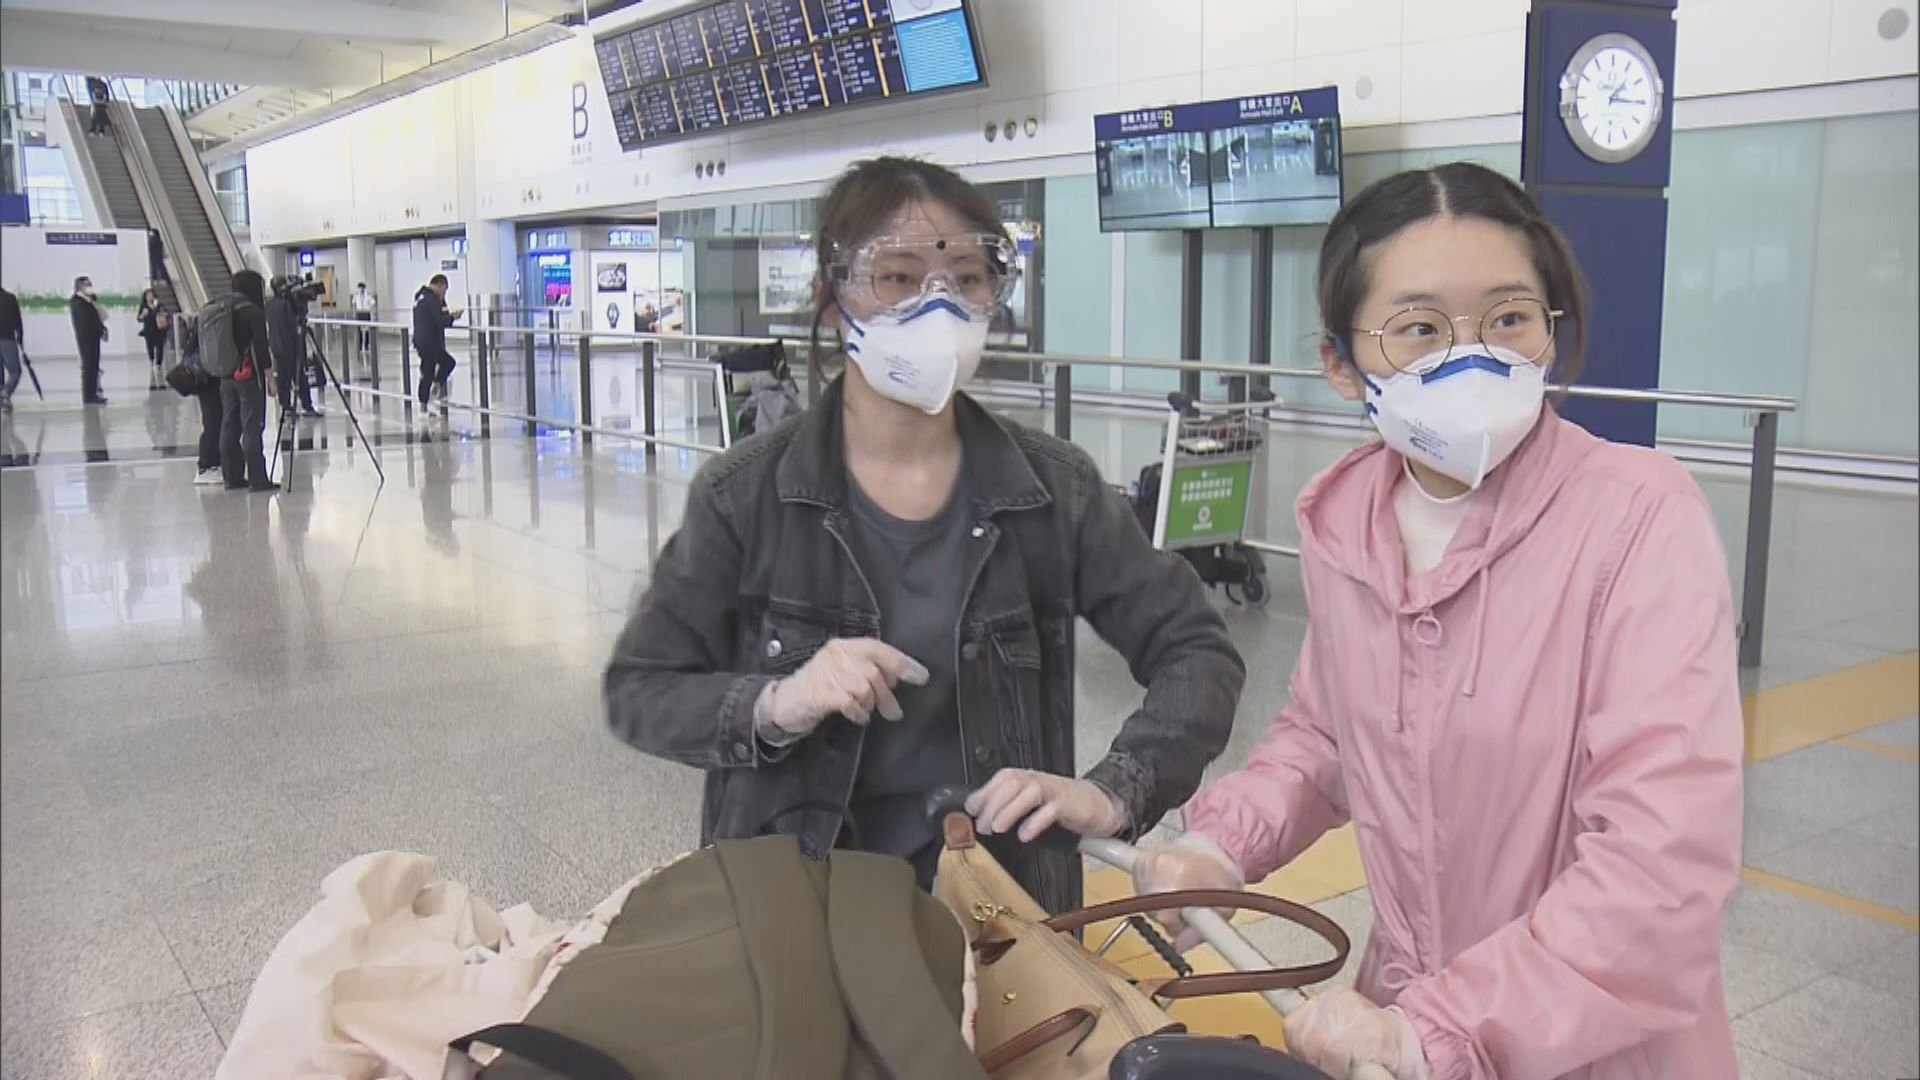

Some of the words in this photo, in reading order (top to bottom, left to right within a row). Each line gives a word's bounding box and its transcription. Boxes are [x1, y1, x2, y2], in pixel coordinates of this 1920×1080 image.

[572, 81, 589, 139] B
[1290, 96, 1303, 114] A
[1164, 110, 1173, 128] B
